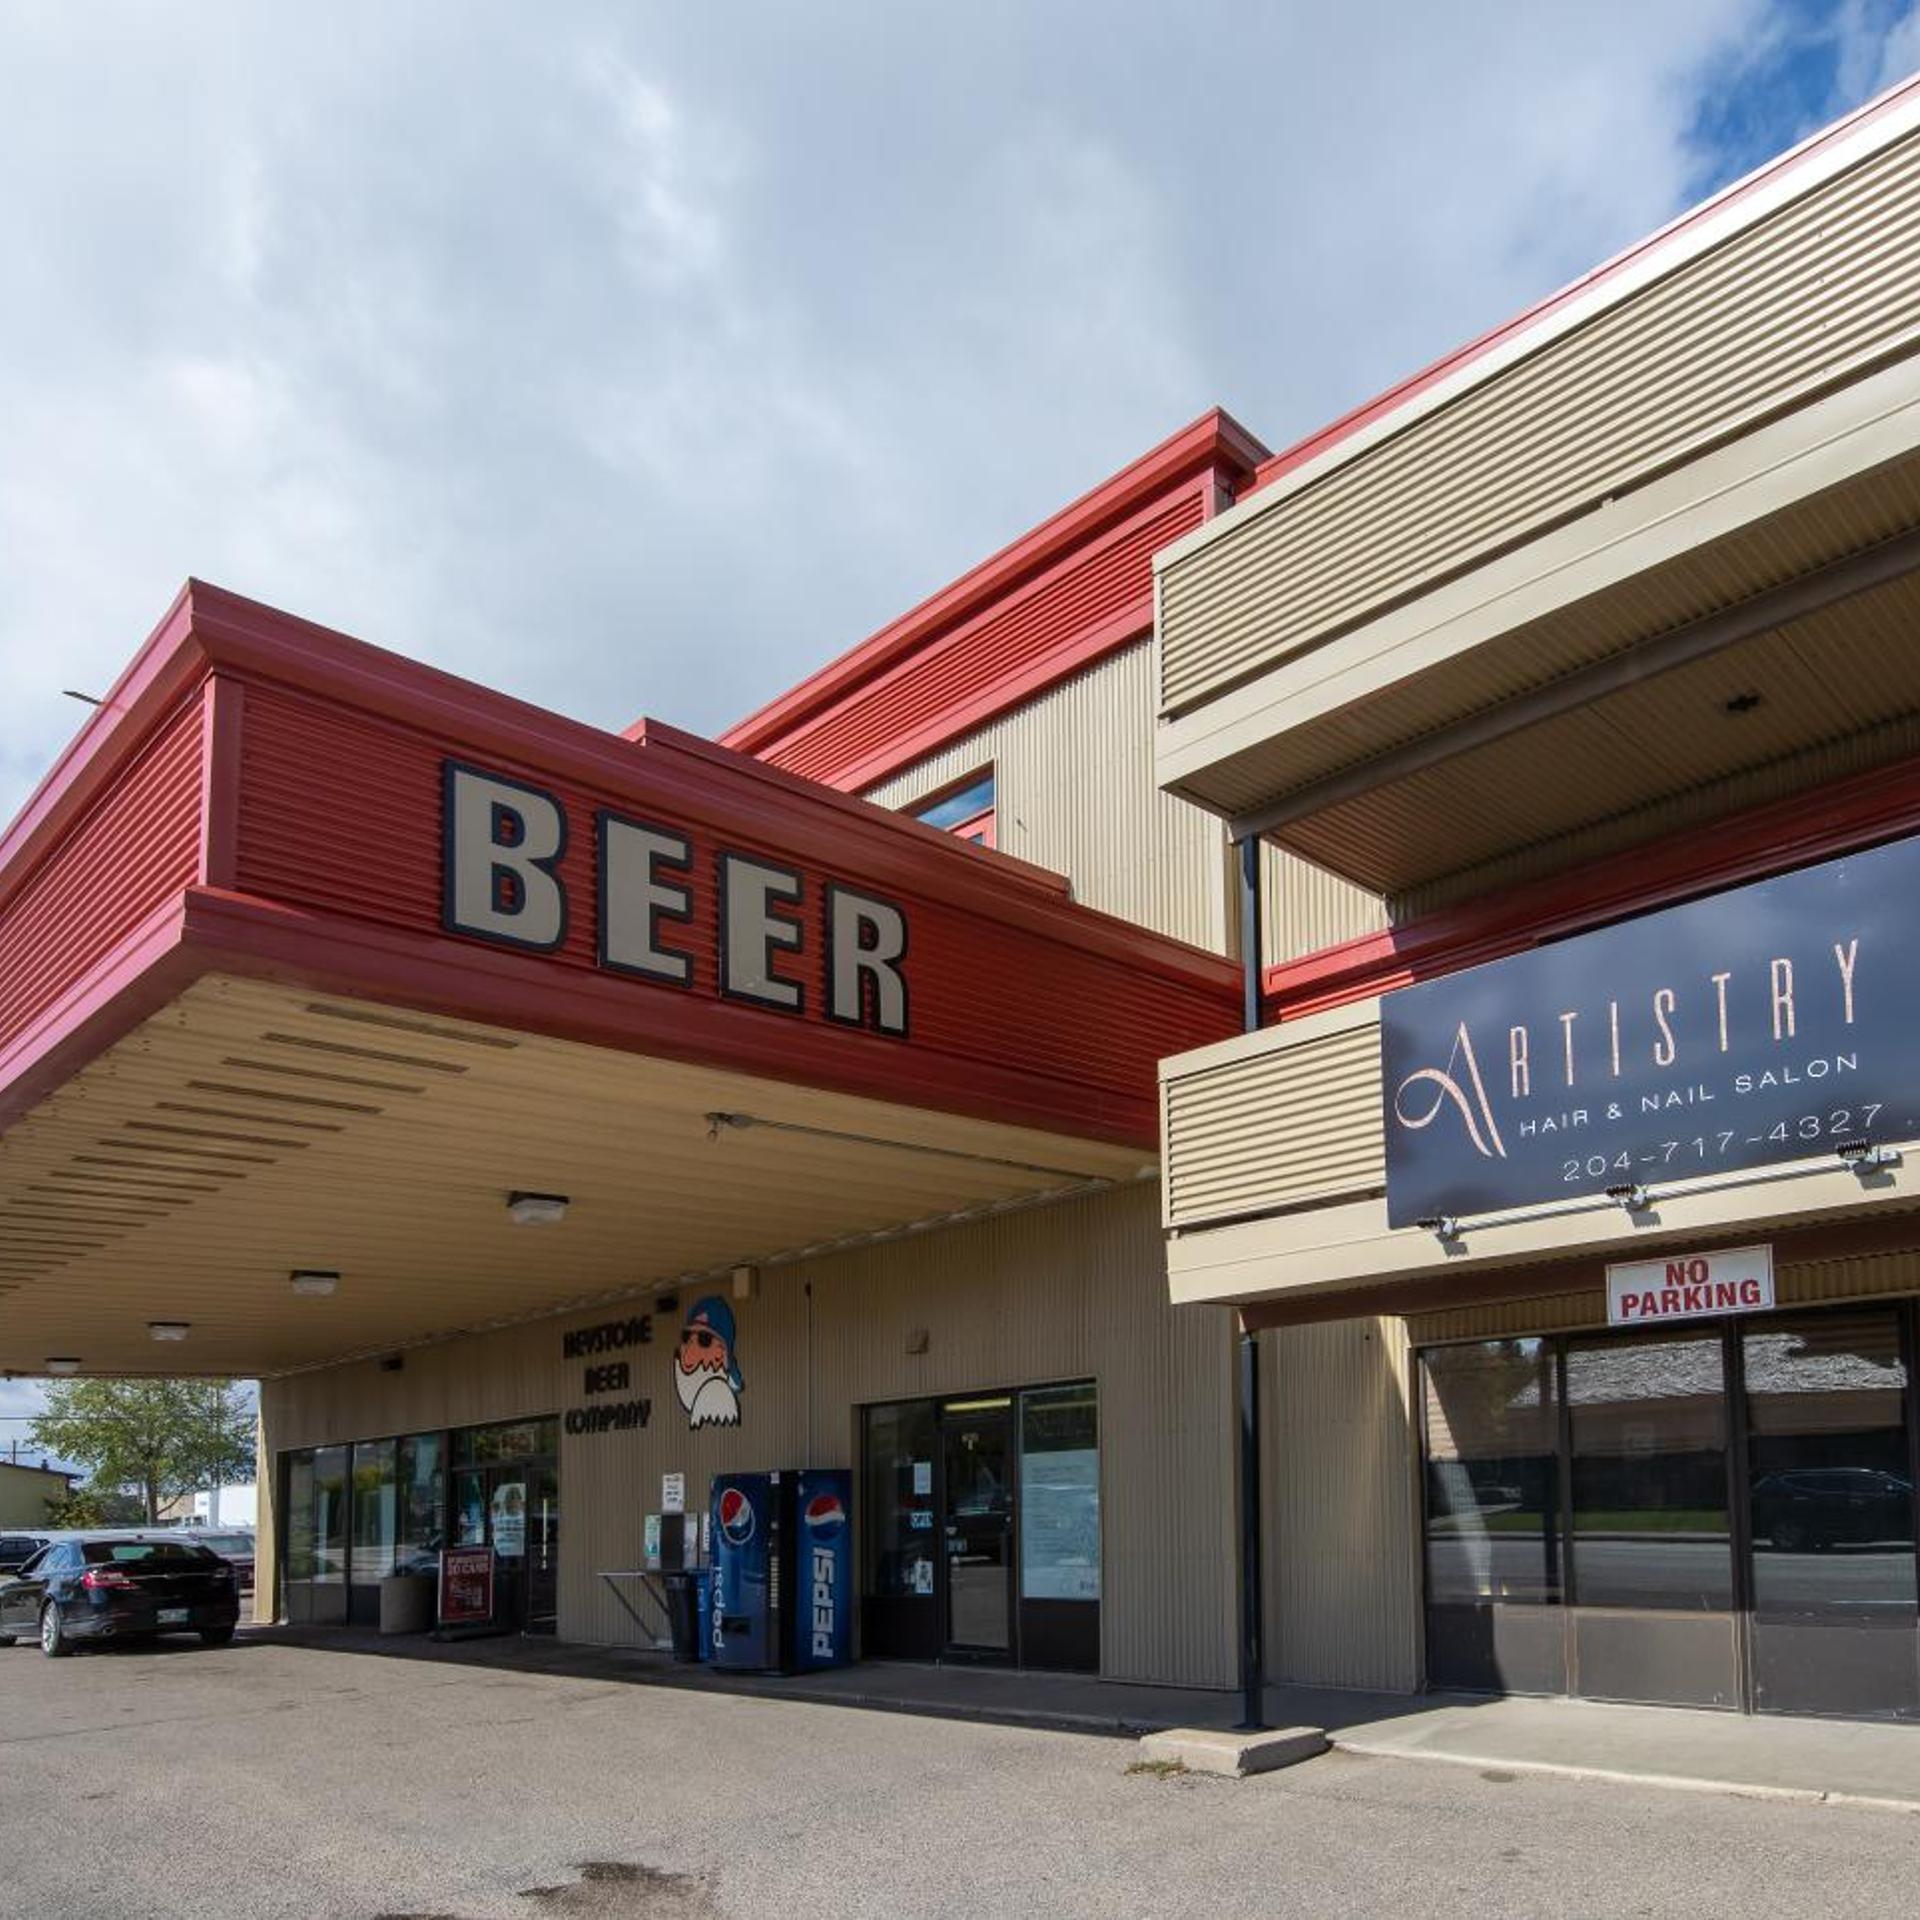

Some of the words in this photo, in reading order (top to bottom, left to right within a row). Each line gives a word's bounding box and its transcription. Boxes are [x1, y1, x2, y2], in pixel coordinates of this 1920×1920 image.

[443, 759, 909, 1043] BEER
[1395, 938, 1859, 1159] ARTISTRY
[1519, 1108, 1589, 1138] HAIR
[1606, 1102, 1624, 1120] &
[1641, 1086, 1716, 1113] NAIL
[1734, 1051, 1859, 1095] SALON
[1562, 1102, 1884, 1183] 204-717-4327
[1620, 1278, 1761, 1319] PARKING
[1665, 1258, 1710, 1288] NO
[563, 1314, 652, 1360] KEYSTONE
[584, 1362, 630, 1395] BEER
[565, 1397, 652, 1436] COMPANY
[812, 1547, 835, 1658] PEPSI
